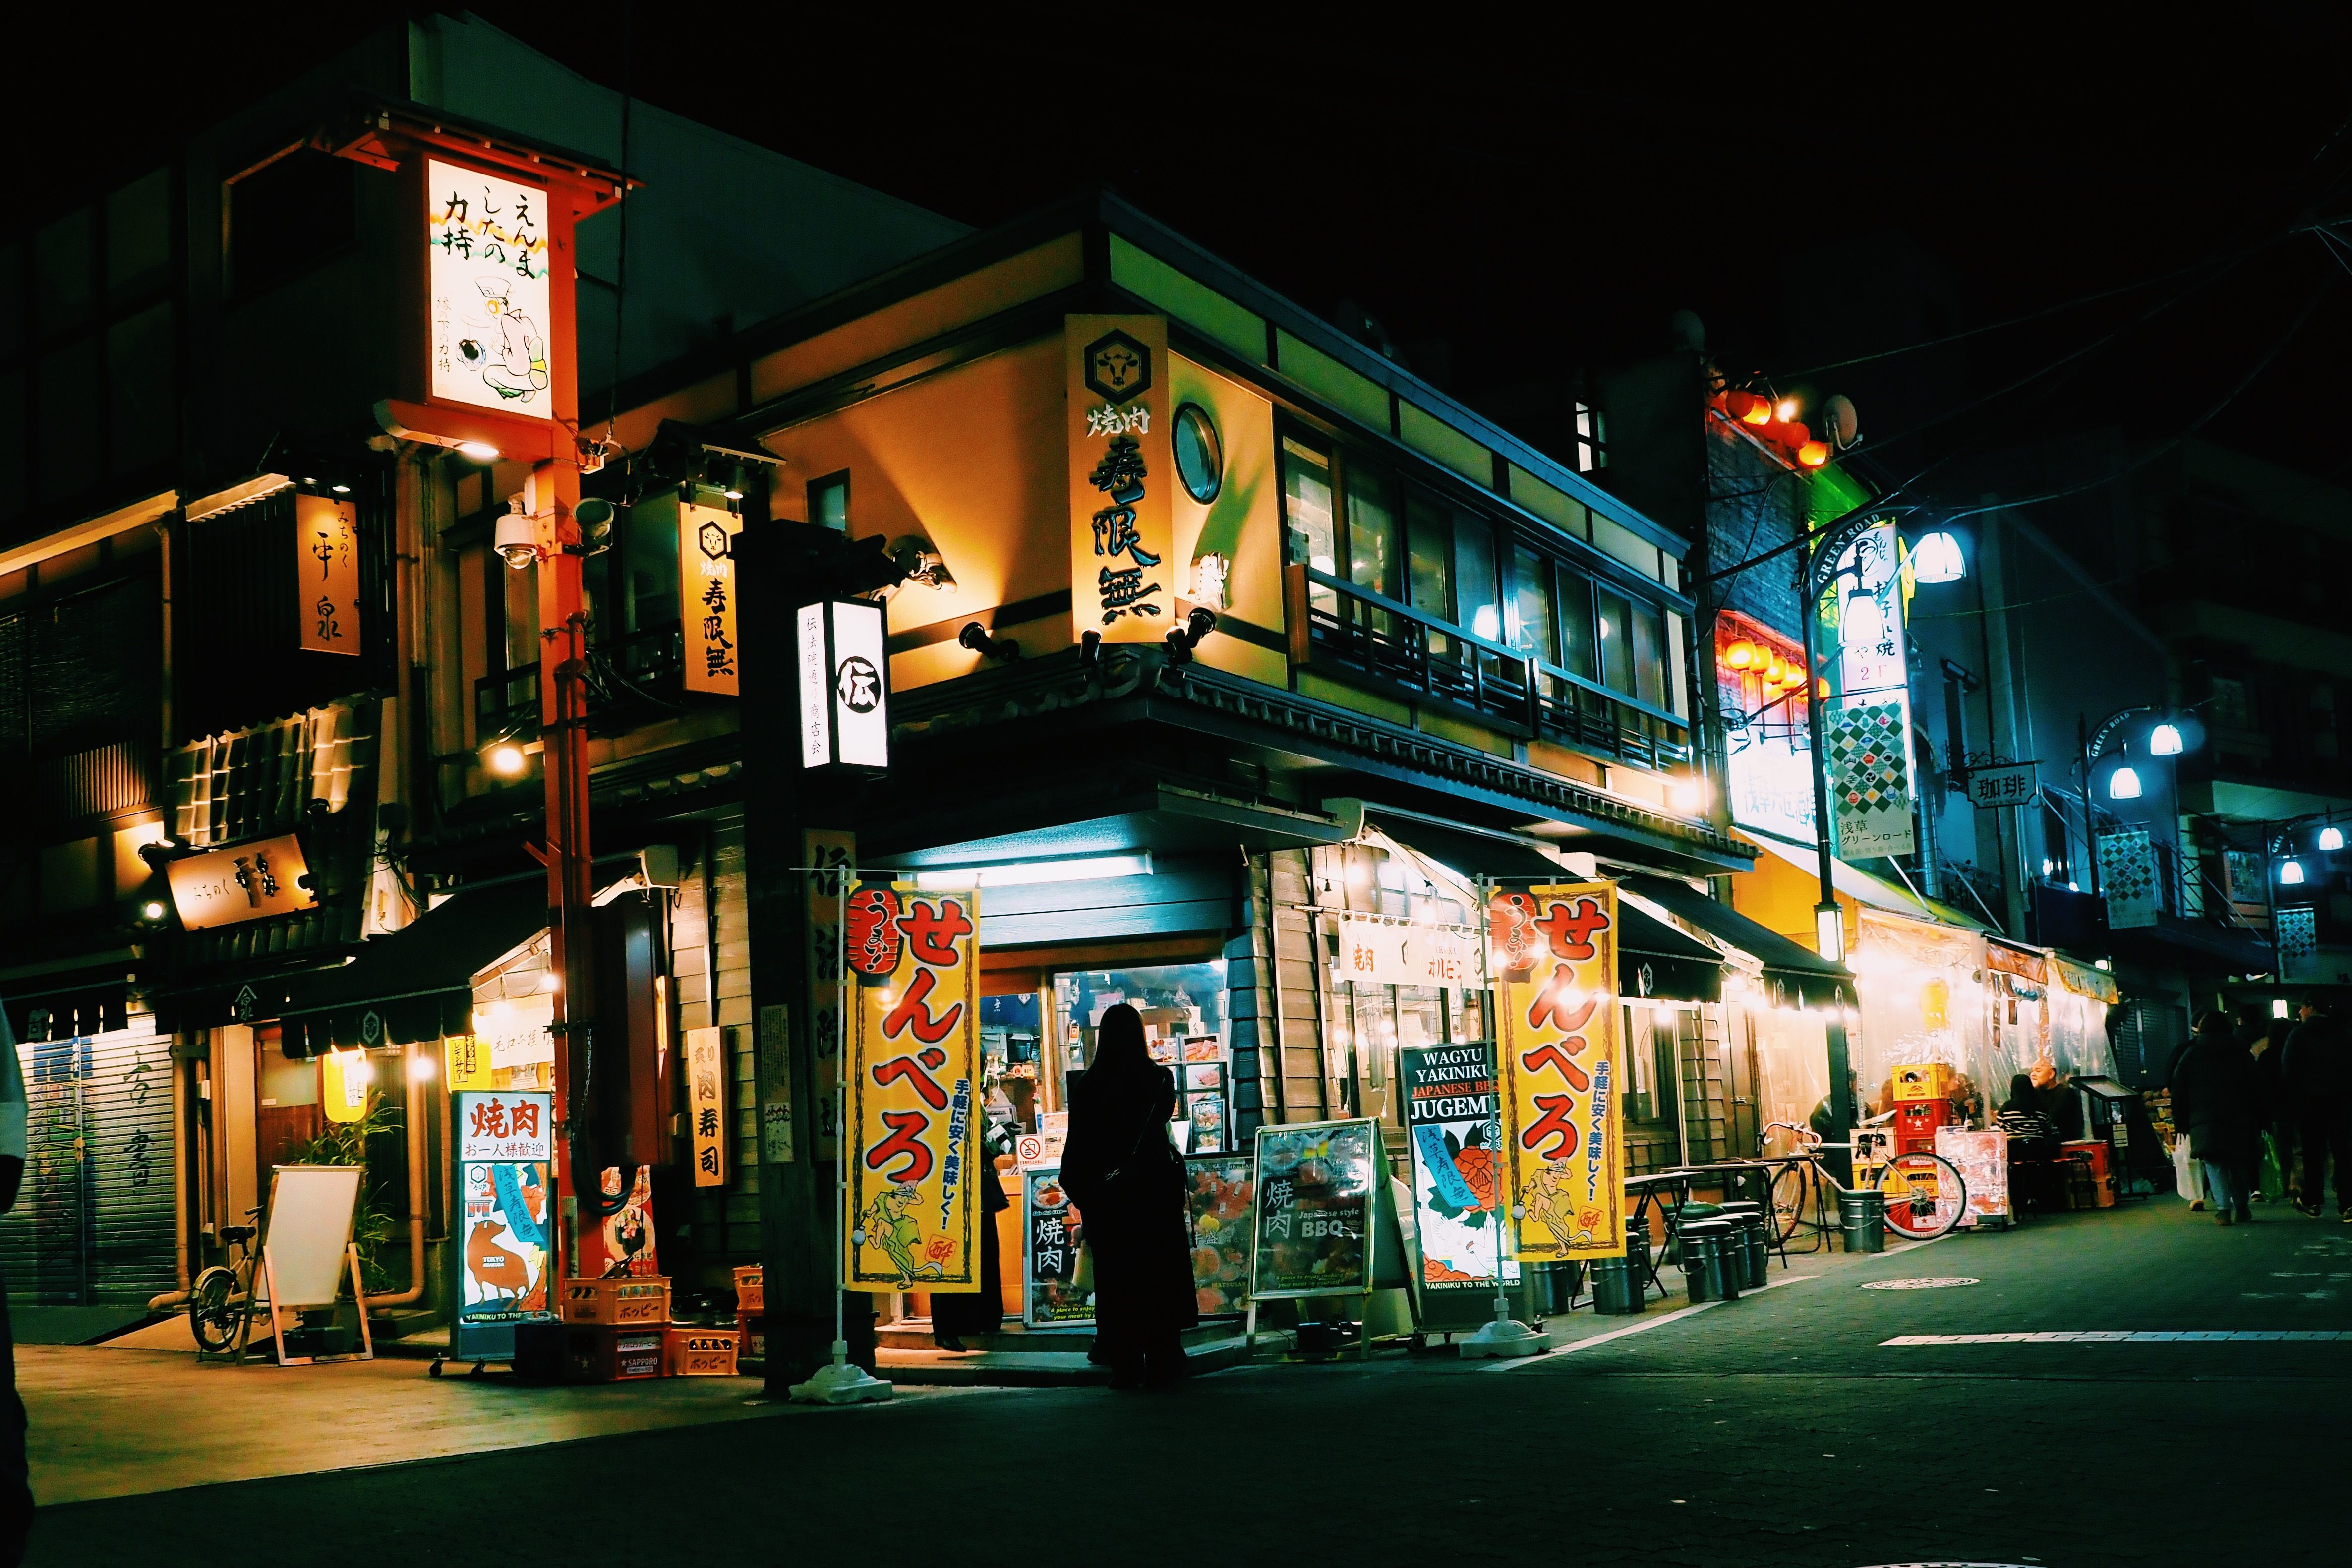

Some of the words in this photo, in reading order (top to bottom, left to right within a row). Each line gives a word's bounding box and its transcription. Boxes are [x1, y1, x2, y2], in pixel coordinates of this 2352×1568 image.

[442, 190, 474, 261] 力持
[482, 186, 505, 264] したの
[514, 194, 537, 279] えんま
[1087, 404, 1150, 438] 焼肉
[338, 510, 349, 569] みちのく
[1089, 436, 1162, 626] 寿限無
[1817, 535, 1845, 584] GREEN
[1847, 514, 1880, 538] ROAD
[699, 560, 728, 577] 焼肉
[702, 577, 734, 678] 寿限無
[806, 617, 821, 755] 伝法院通り商店会
[837, 656, 878, 707] 伝
[2091, 728, 2109, 757] GREEN
[2109, 713, 2129, 728] ROAD
[1977, 774, 2026, 800] 珈琲
[1841, 819, 1868, 835] 浅草
[1842, 829, 1911, 846] グリーンロード
[1353, 943, 1374, 972] 焼肉
[865, 898, 974, 1185] せんべろ
[1522, 898, 1610, 1161] せんべろ
[454, 1042, 464, 1080] レモンサワー
[1422, 1048, 1483, 1066] WAGYU
[1412, 1082, 1472, 1098] JAPANESE
[470, 1097, 540, 1139] 焼肉
[697, 1069, 718, 1177] 肉寿司
[465, 1142, 545, 1158] お一人様歓迎
[1422, 1127, 1469, 1203] 浅草寿限無
[1265, 1179, 1294, 1239] 焼肉
[1298, 1211, 1338, 1220] Japanese
[1340, 1208, 1360, 1218] style
[1301, 1220, 1344, 1238] BBQ
[1035, 1217, 1065, 1274] 焼肉
[619, 1302, 659, 1319] ホッピー
[628, 1357, 658, 1366] SAPPORO
[690, 1356, 727, 1370] ホッピー
